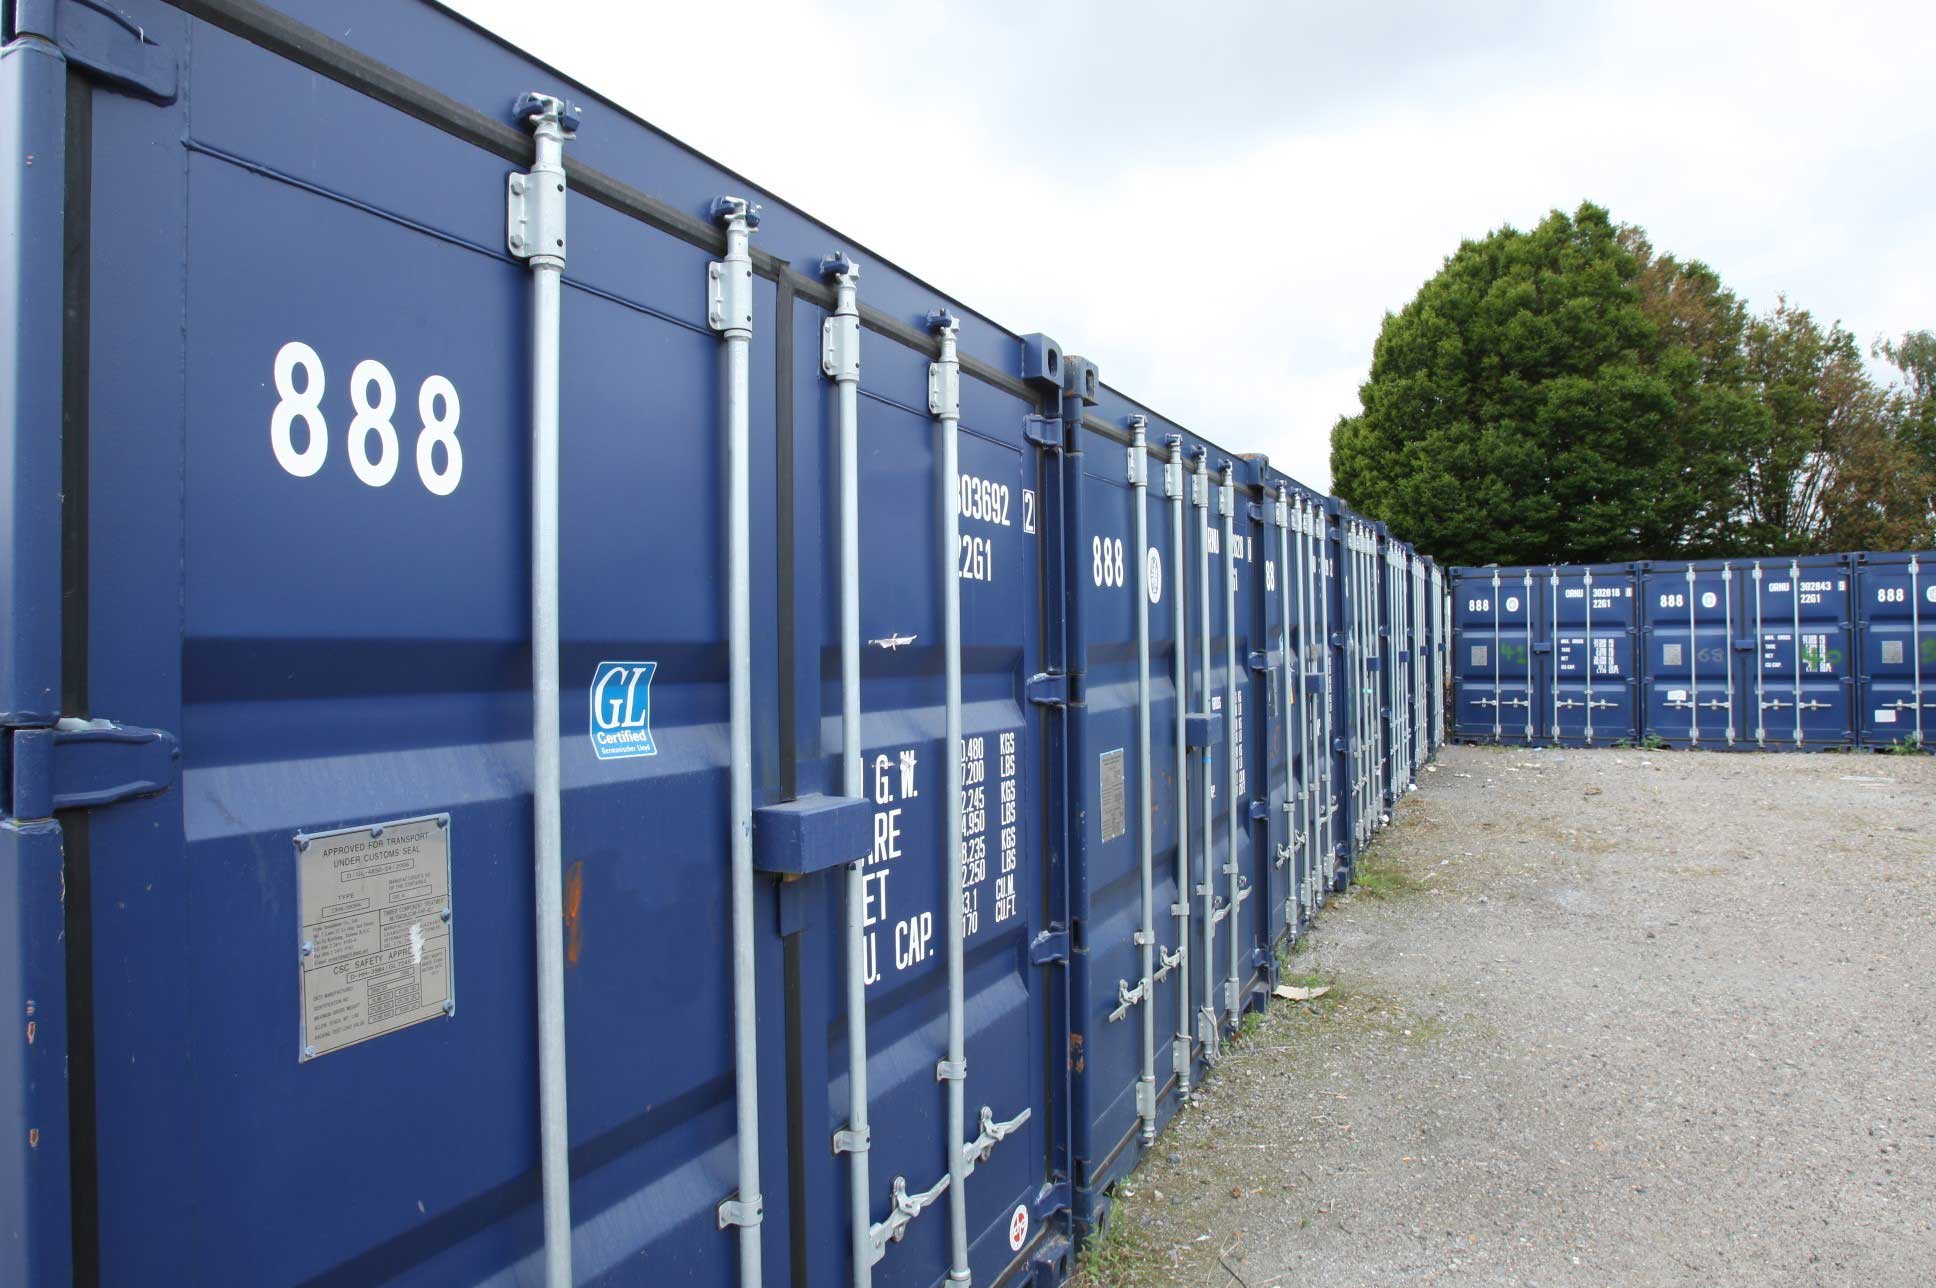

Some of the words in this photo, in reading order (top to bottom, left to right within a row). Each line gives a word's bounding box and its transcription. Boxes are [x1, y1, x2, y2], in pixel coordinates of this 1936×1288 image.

[271, 341, 463, 496] 888
[1024, 491, 1035, 532] 2
[958, 534, 992, 582] 2G1
[1093, 535, 1124, 587] 888
[1265, 560, 1275, 591] 88
[1800, 581, 1832, 591] 302843
[1468, 599, 1489, 612] 888
[1592, 588, 1621, 598] 302818
[1659, 594, 1683, 607] 888
[1877, 588, 1904, 602] 888
[594, 666, 647, 729] GL
[597, 730, 647, 745] Certified
[961, 737, 984, 762] 0,480
[1000, 733, 1015, 755] KGS
[961, 760, 984, 786] 7,200
[1000, 755, 1015, 777] LBS
[1001, 780, 1015, 803] KGS
[1001, 801, 1015, 825] LBS
[323, 843, 365, 857] APPROVED
[368, 840, 384, 849] FOR
[386, 832, 429, 846] TRANSPORT
[862, 808, 902, 866] RE
[961, 836, 985, 864] 8,235
[1001, 826, 1016, 850] KGS
[333, 857, 361, 868] UNDER
[363, 848, 400, 862] CUSTOMS
[402, 845, 420, 856] SEAL
[962, 859, 986, 888] 2,250
[1001, 848, 1016, 873] LBS
[338, 892, 354, 901] TYPE
[862, 869, 889, 926] ET
[963, 888, 977, 914] 3.1
[962, 912, 978, 938] 170
[863, 932, 880, 985] U.
[895, 912, 934, 970] CAP.
[333, 963, 350, 975] CSC
[354, 955, 383, 969] SAFETY
